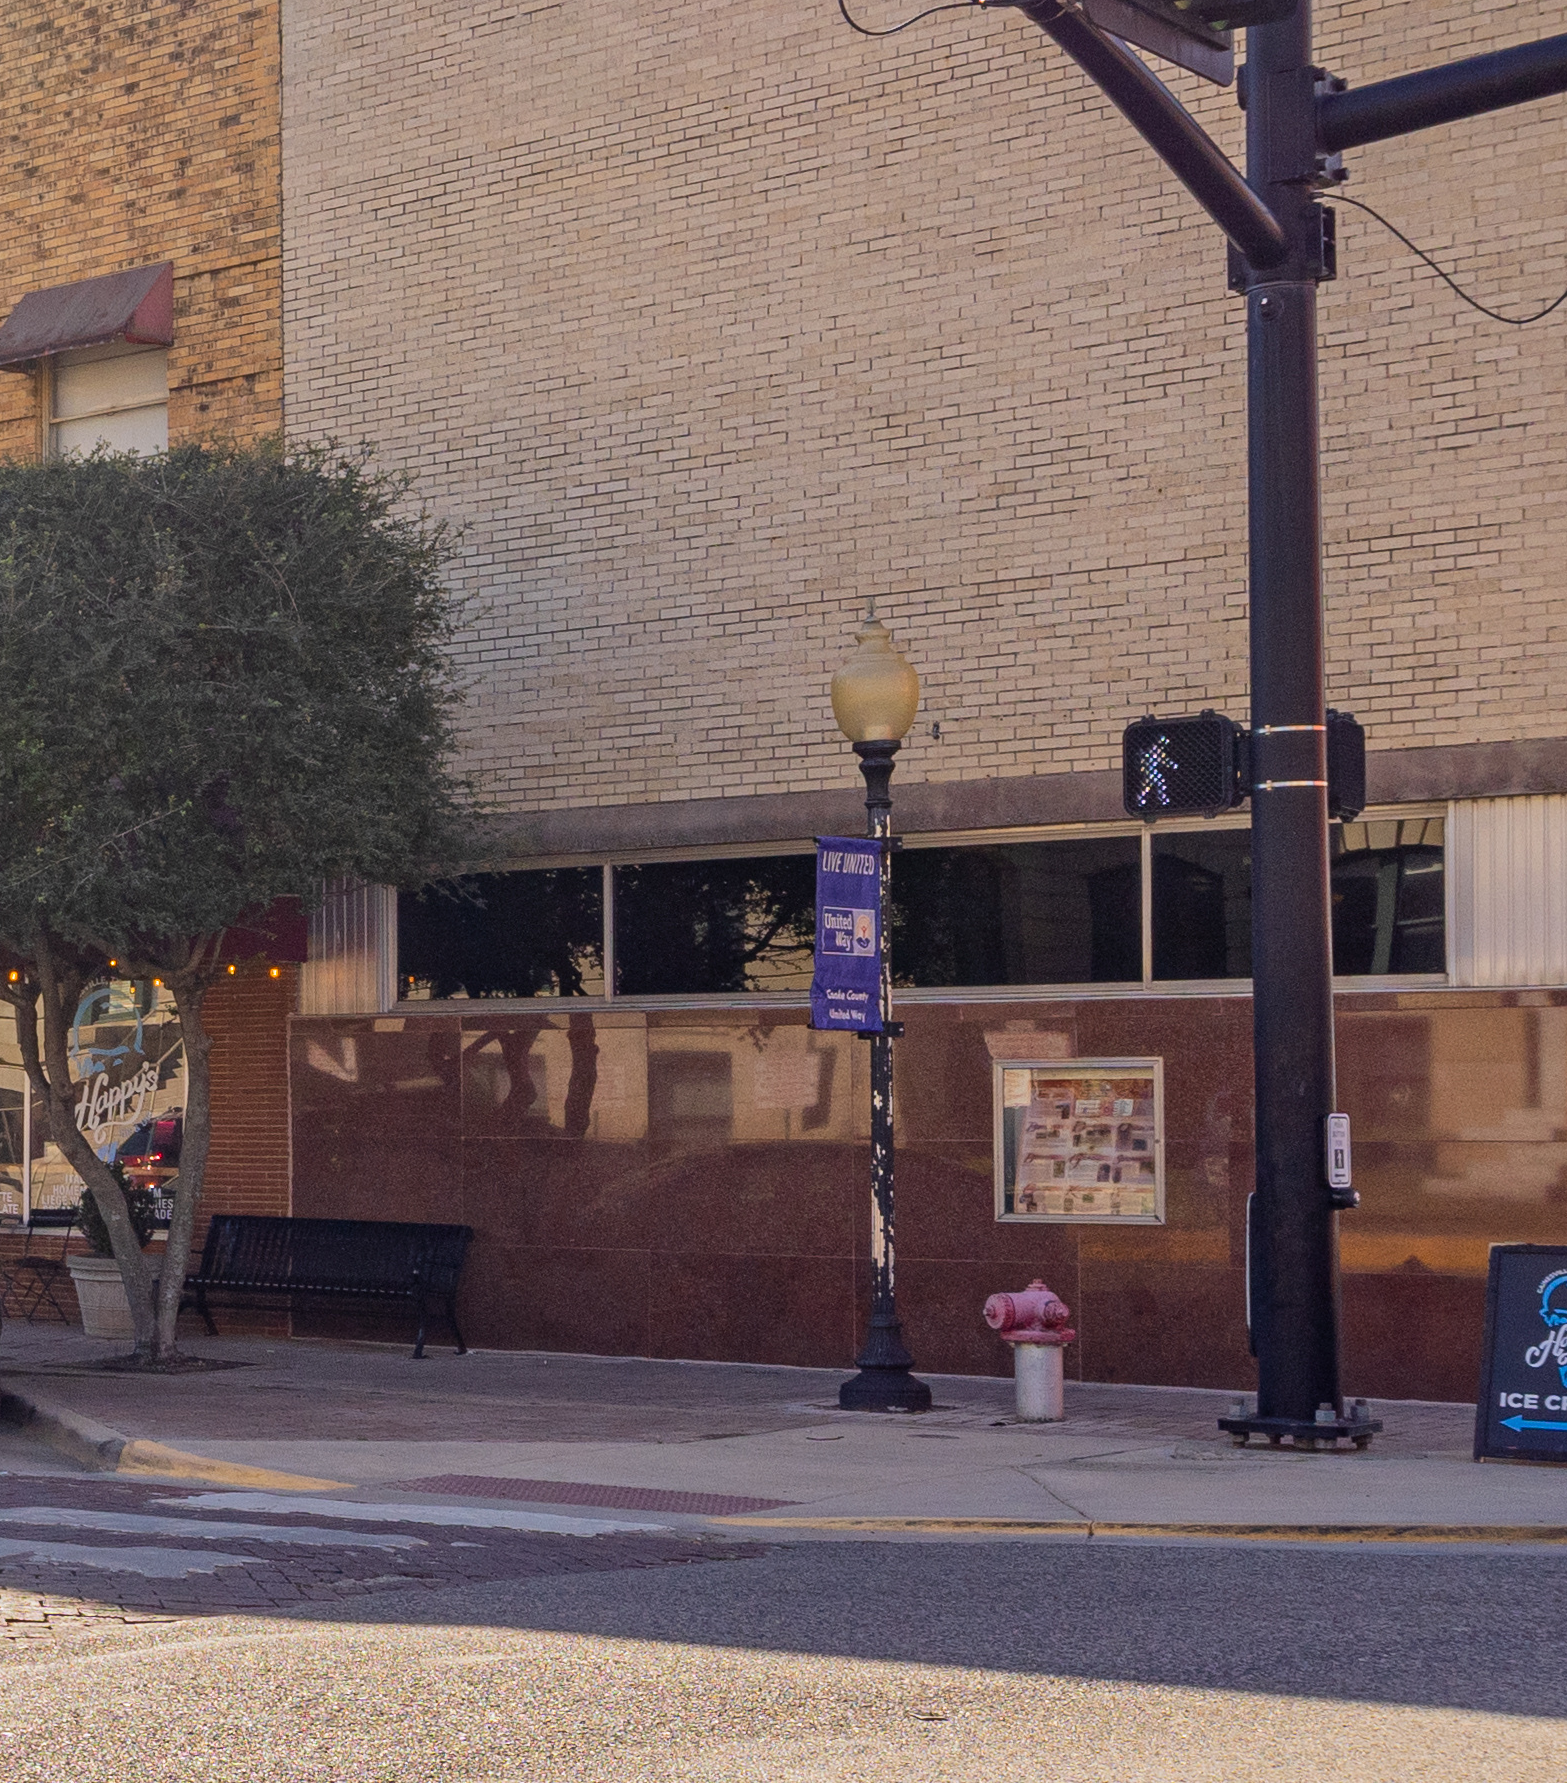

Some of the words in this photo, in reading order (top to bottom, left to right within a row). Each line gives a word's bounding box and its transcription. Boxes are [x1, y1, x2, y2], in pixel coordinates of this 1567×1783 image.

[822, 851, 841, 873] LIVE
[842, 852, 876, 875] UNITED
[824, 913, 853, 930] United
[835, 930, 852, 952] Way
[75, 1061, 159, 1145] Happy's
[1499, 1391, 1540, 1410] ICE
